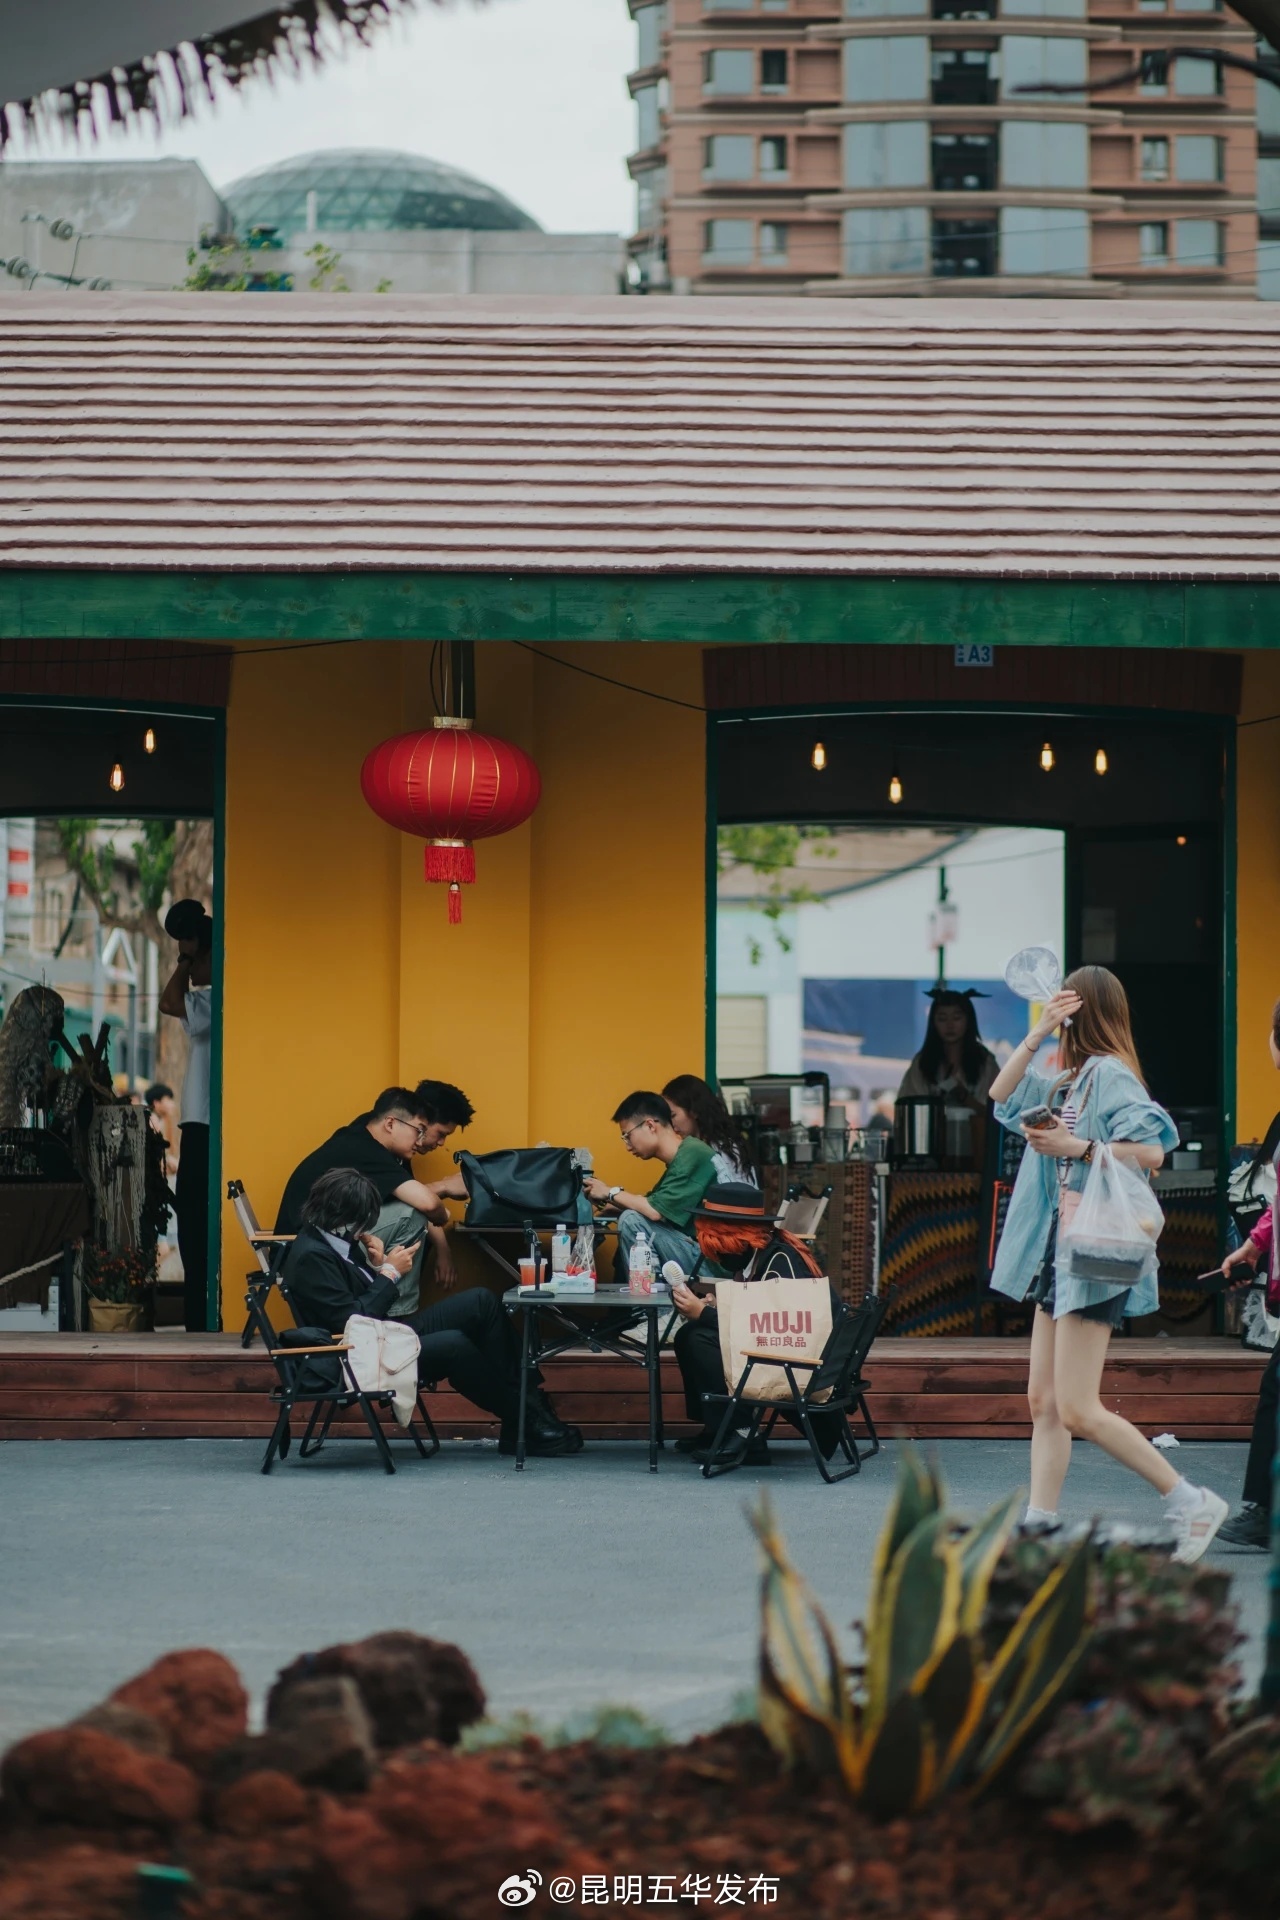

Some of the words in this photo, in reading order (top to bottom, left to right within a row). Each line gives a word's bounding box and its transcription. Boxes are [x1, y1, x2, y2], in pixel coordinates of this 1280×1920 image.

[968, 644, 991, 663] A3
[749, 1310, 812, 1334] MUJI
[755, 1335, 807, 1348] 無印良品
